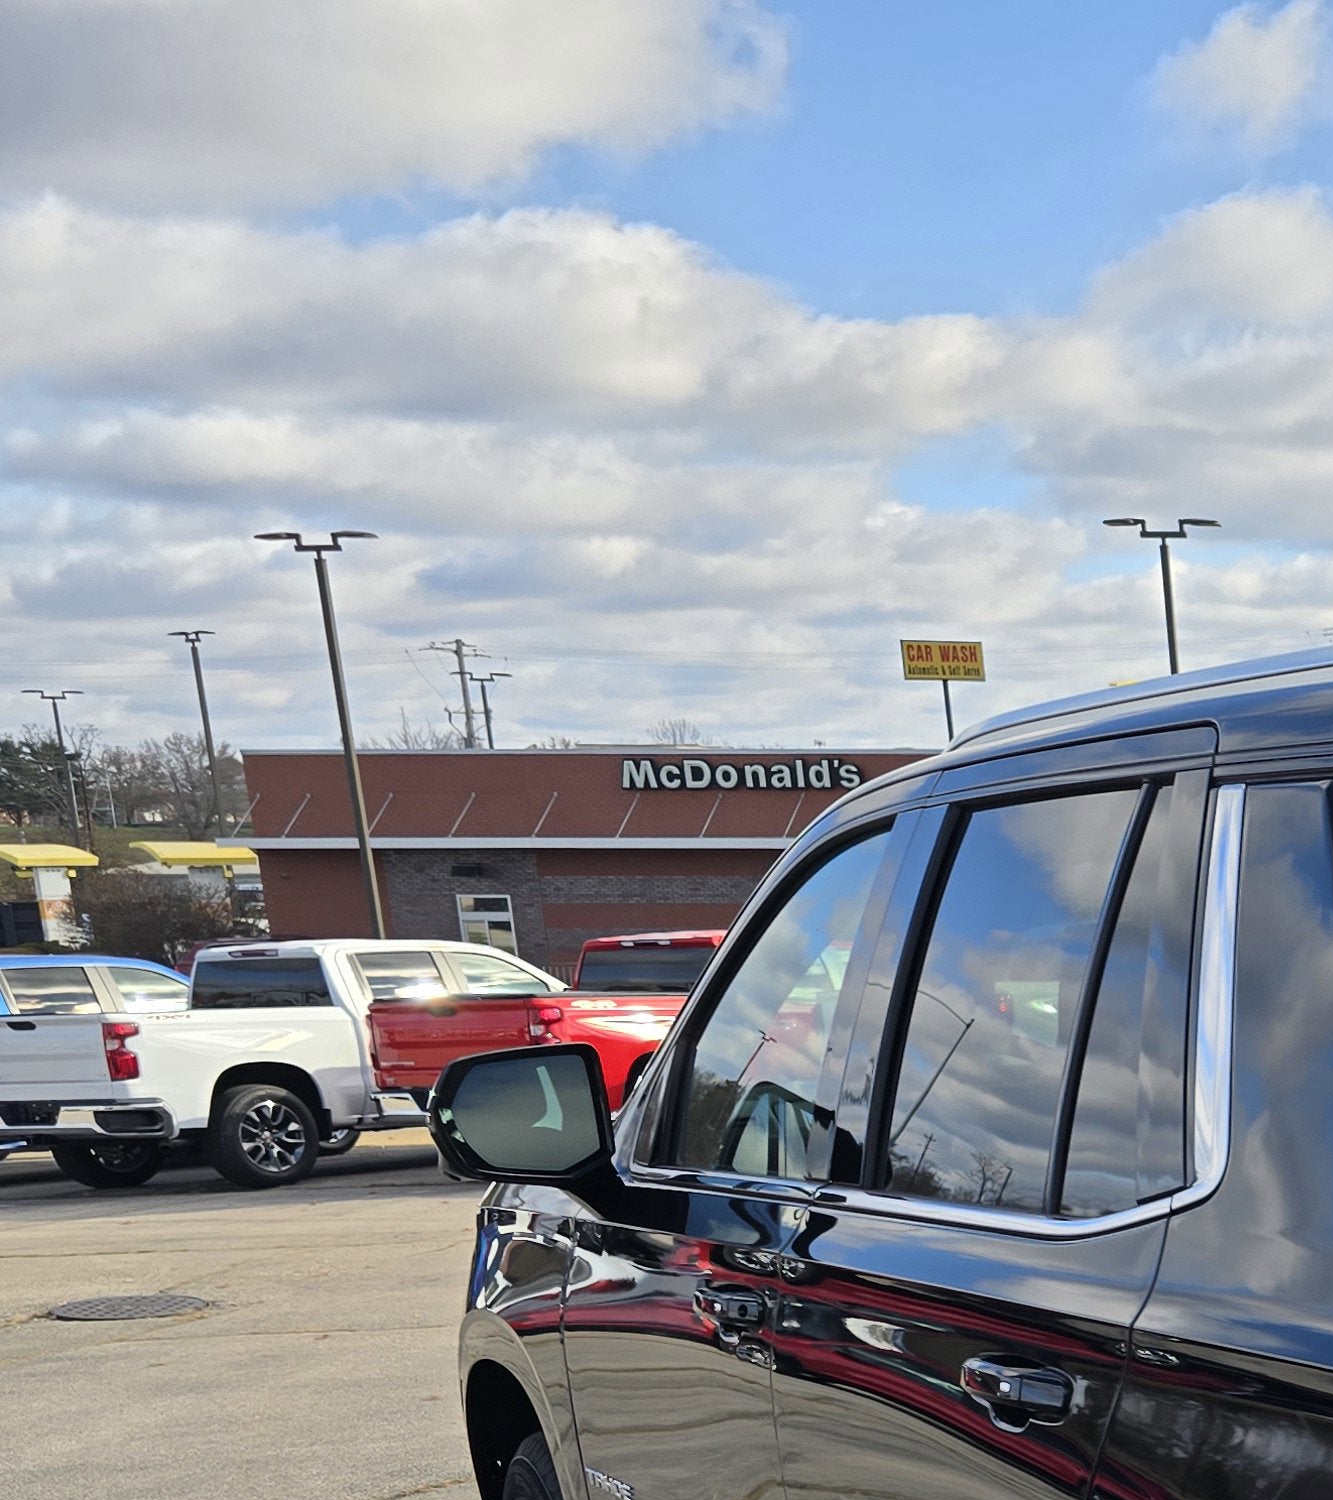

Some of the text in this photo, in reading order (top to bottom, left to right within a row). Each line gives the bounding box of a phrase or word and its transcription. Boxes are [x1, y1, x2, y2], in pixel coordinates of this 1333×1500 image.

[906, 644, 978, 663] CAR WASH
[621, 759, 861, 790] McDonald's
